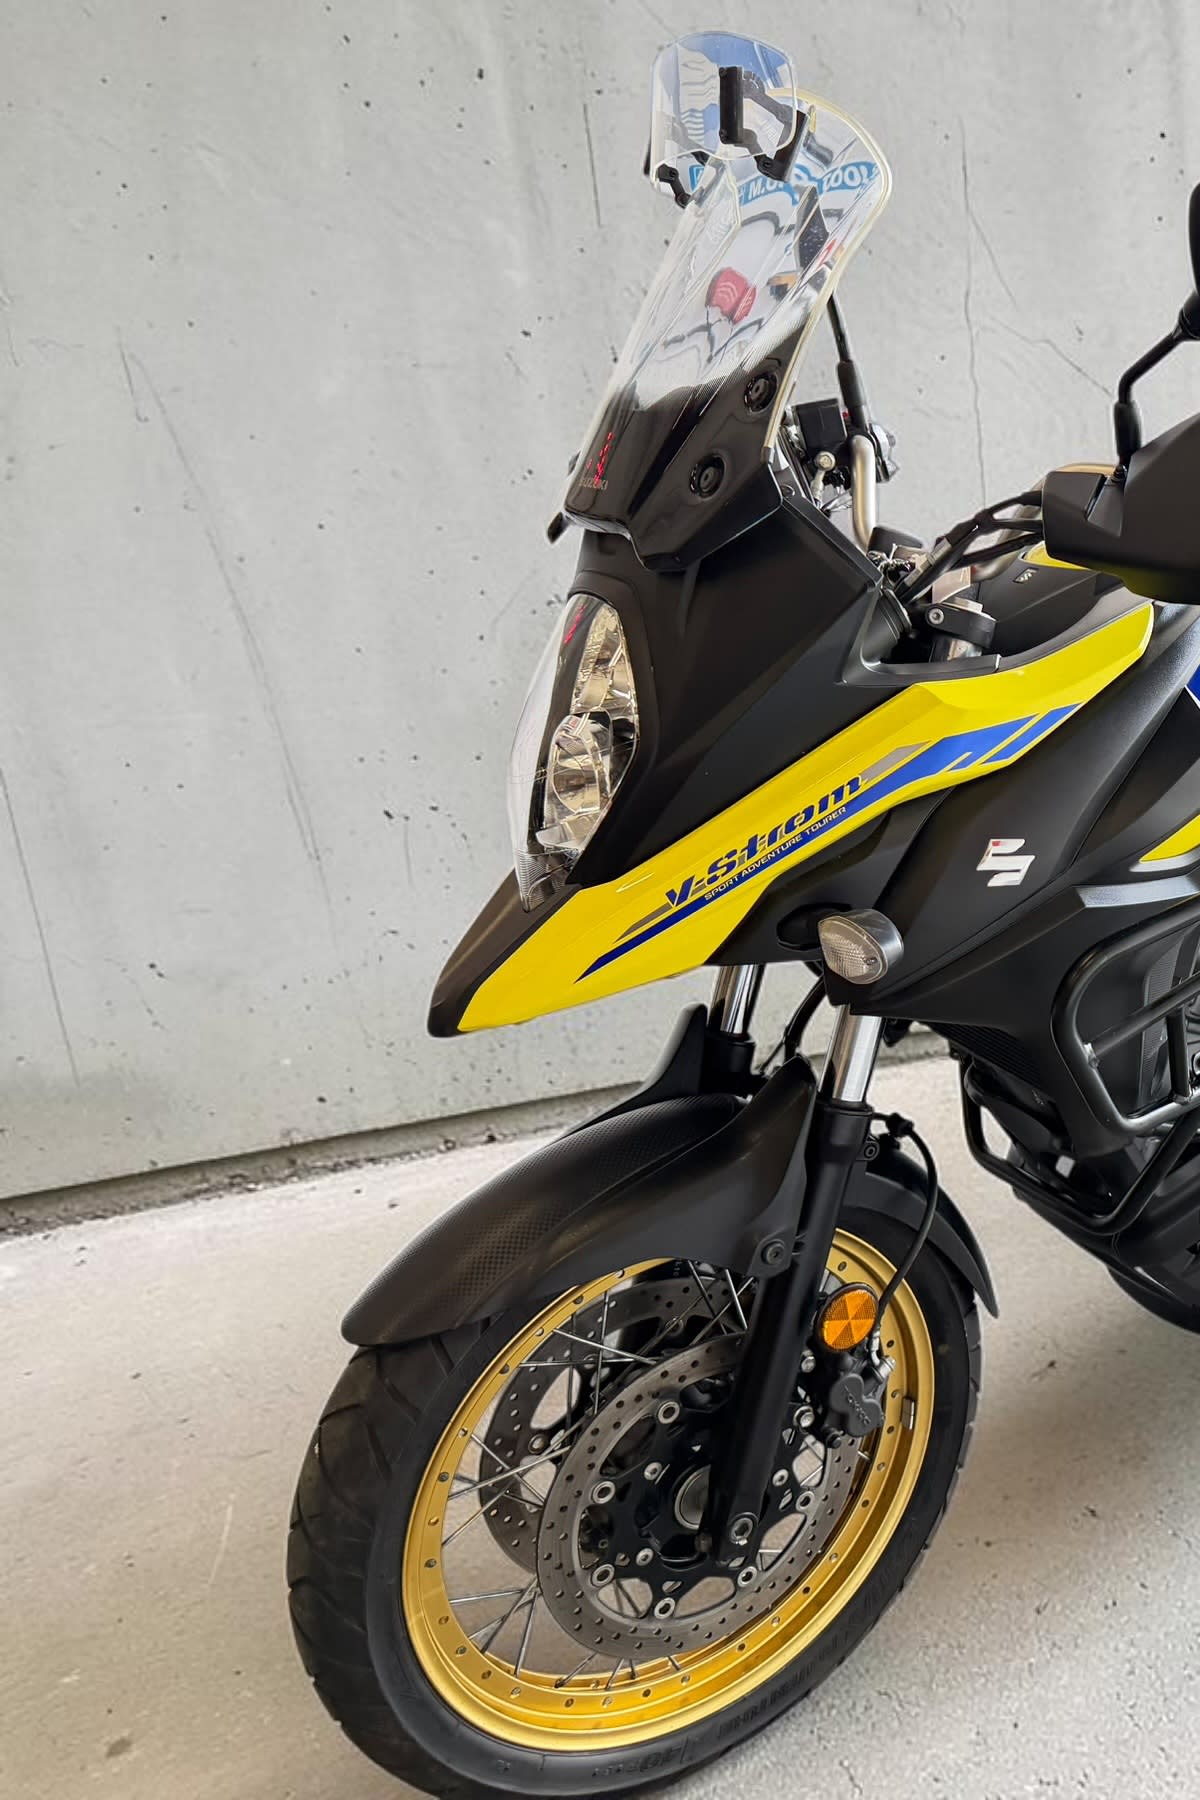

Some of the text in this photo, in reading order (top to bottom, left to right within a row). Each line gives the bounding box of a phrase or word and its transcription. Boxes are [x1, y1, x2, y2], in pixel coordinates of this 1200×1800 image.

[665, 775, 866, 907] V-Strom
[704, 805, 847, 901] SPORT ADVENTURE TOURER
